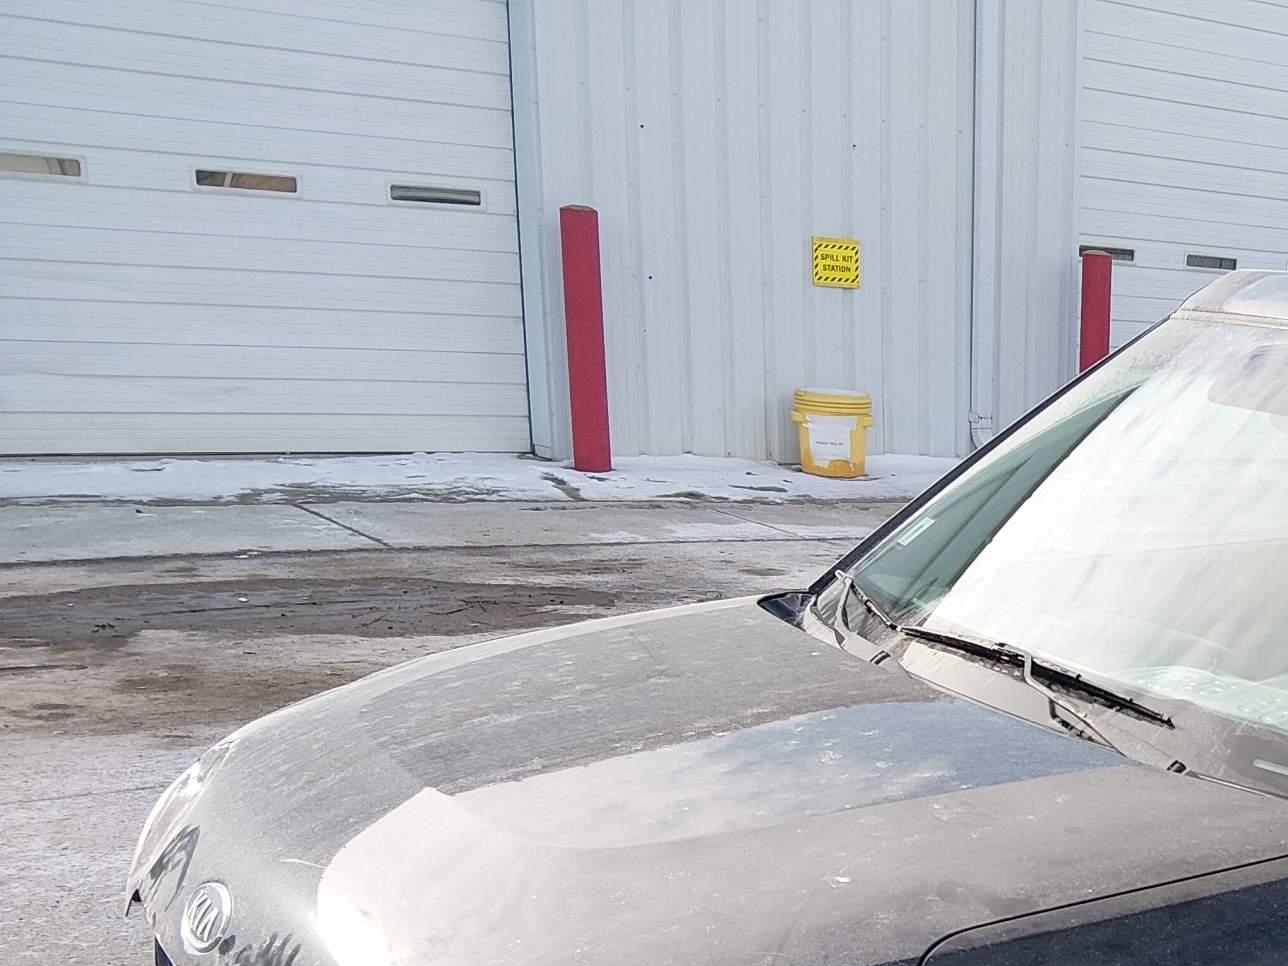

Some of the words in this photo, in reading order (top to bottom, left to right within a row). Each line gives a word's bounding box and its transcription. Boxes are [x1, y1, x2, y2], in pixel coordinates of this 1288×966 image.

[820, 253, 840, 262] SPILL
[842, 255, 854, 263] KIT
[822, 264, 851, 273] STATION
